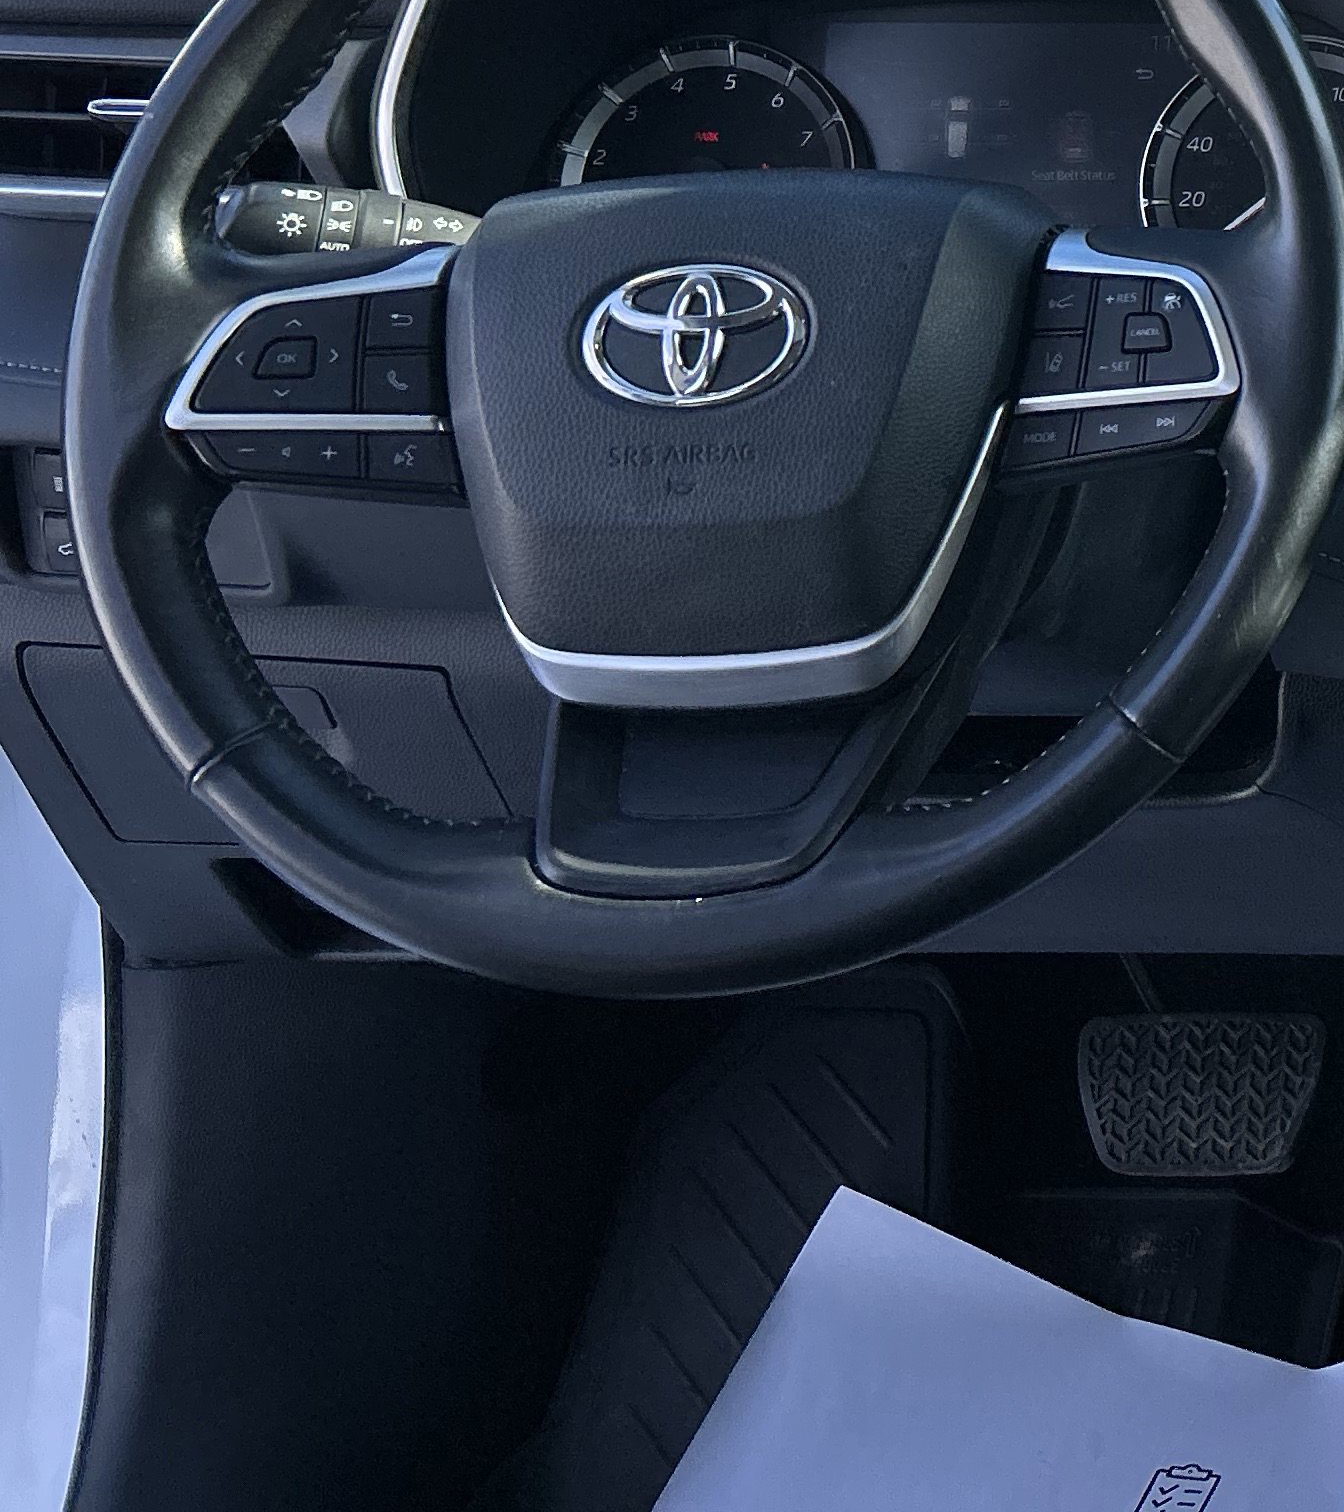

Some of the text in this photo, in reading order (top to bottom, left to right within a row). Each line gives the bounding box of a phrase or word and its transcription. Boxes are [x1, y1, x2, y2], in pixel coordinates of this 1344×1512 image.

[670, 77, 685, 94] 4
[723, 73, 738, 91] 5
[770, 91, 785, 109] 6
[624, 104, 639, 122] 3
[800, 130, 814, 147] 7
[1185, 135, 1214, 154] 40
[591, 148, 607, 166] 2
[1178, 190, 1206, 208] 20
[319, 240, 351, 252] AUTO
[276, 352, 297, 365] OK
[1022, 430, 1057, 444] MODE
[608, 442, 757, 468] SRS AIRBAG
